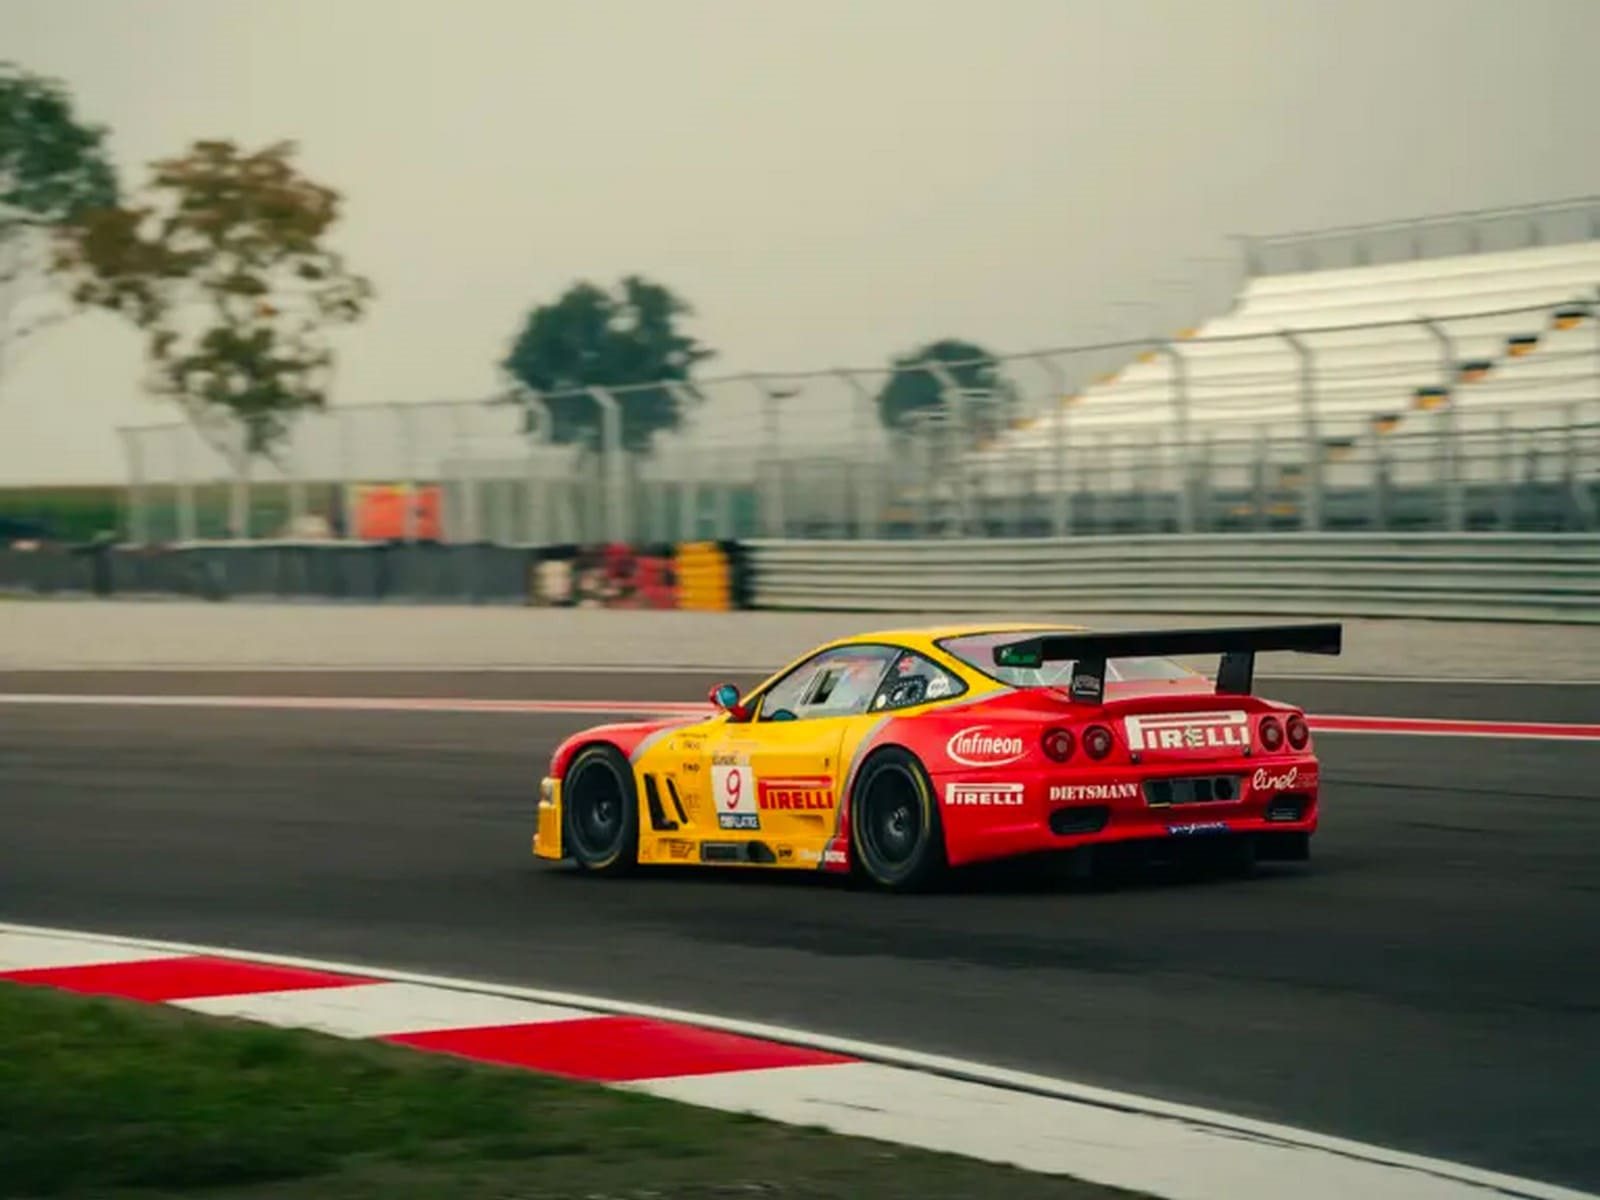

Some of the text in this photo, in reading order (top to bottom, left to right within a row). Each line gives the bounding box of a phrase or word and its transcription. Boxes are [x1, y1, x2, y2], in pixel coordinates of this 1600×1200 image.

[956, 732, 1023, 754] Infineon
[1124, 710, 1250, 750] PIRELLI
[726, 769, 741, 810] 9
[758, 775, 834, 810] PIRELLI
[945, 783, 1025, 805] PIRELLI
[1050, 783, 1139, 801] DIETSMANN
